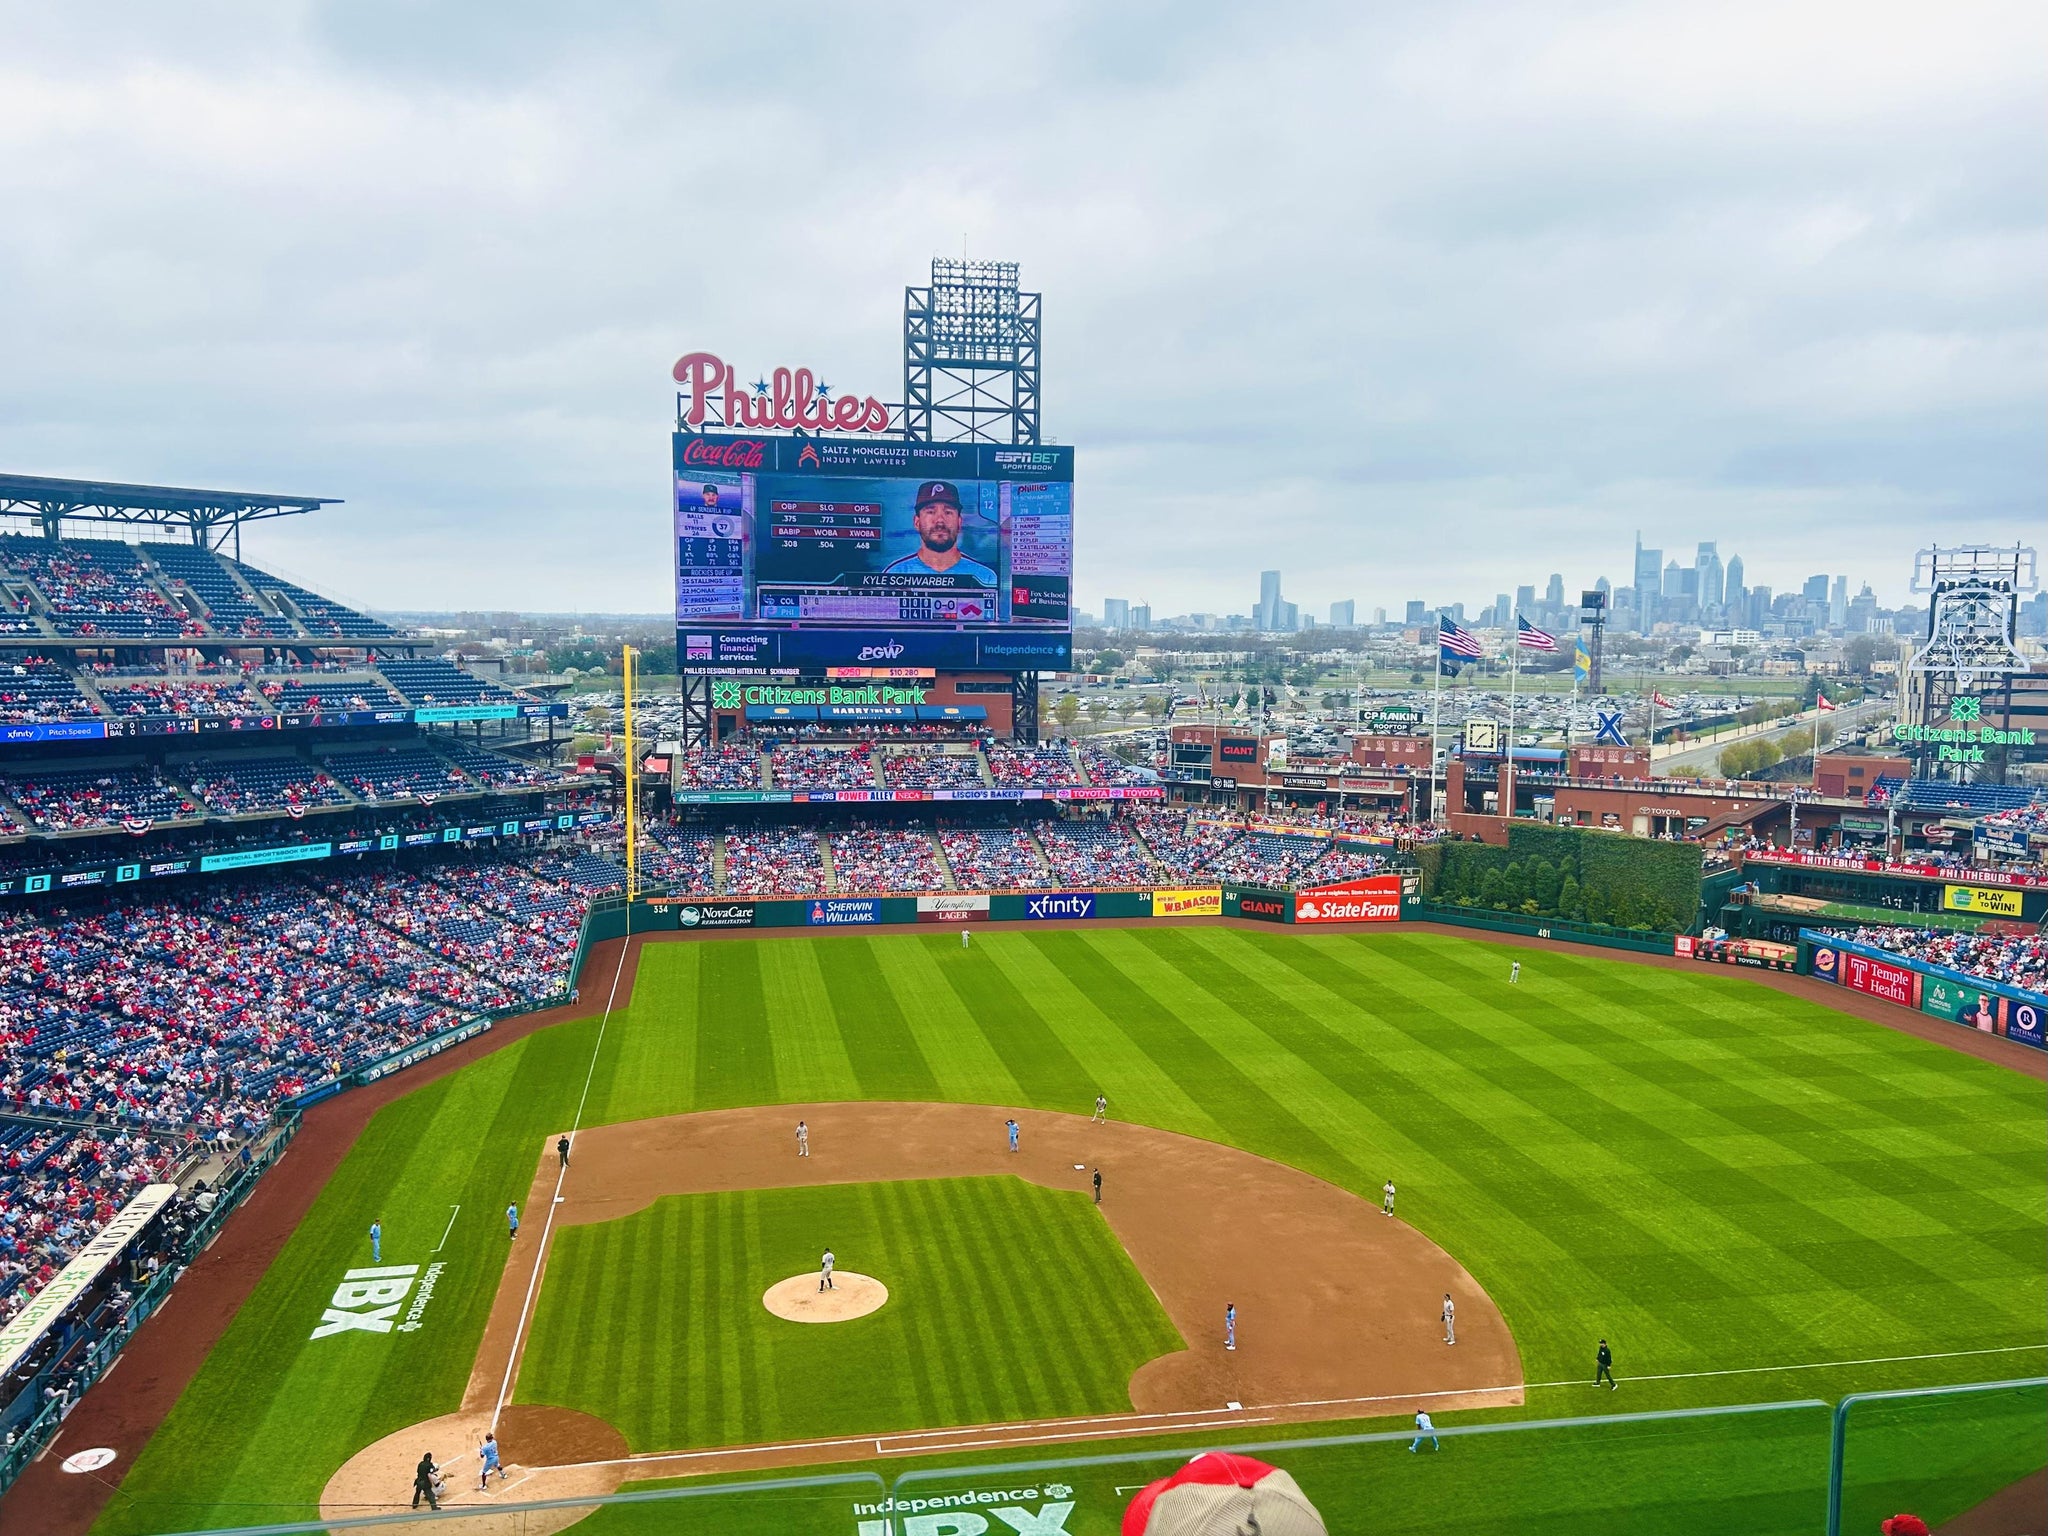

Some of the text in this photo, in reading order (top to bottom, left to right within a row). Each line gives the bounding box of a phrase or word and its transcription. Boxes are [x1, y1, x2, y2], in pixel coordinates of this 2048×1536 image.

[673, 352, 889, 432] Phillies
[822, 445, 958, 459] SALTZ MONGELUZZI BENDESKY
[822, 456, 906, 466] INJURY LAWYERS
[982, 488, 996, 498] DH
[984, 501, 993, 510] 12
[863, 576, 955, 586] KYLE SCHWARBER
[1043, 591, 1066, 599] School
[720, 635, 768, 645] Connecting
[720, 644, 757, 652] financial
[863, 646, 900, 659] PGW
[984, 645, 1053, 656] Independence
[720, 653, 757, 661] services.
[745, 685, 926, 705] Citizens Bank Park
[7, 730, 34, 739] xfinity
[68, 728, 91, 736] Speed
[1894, 724, 2035, 745] Citizens Bank
[1223, 747, 1254, 756] GIANT
[1939, 745, 1984, 763] Park
[838, 792, 894, 800] POWER ALLEY
[952, 789, 1024, 798] LISCIO'S BAKERY
[1072, 790, 1109, 798] TOYOTA
[1125, 789, 1161, 797] TOYOTA
[1651, 808, 1681, 816] TOYOTA
[1750, 851, 1793, 862] Budweiser
[1139, 893, 1151, 901] 374
[1226, 892, 1237, 900] 387
[1408, 897, 1420, 905] 409
[1978, 892, 2004, 902] PLAY
[827, 901, 872, 911] SHERWIN
[931, 896, 976, 910] Yuengling
[1029, 895, 1091, 918] xfinity
[1240, 900, 1283, 914] GIANT
[1990, 902, 2015, 912] WIN!
[654, 905, 668, 913] 334
[701, 906, 753, 918] NovaCare
[939, 911, 968, 920] LAGER
[1537, 928, 1550, 938] 401
[1738, 957, 1761, 965] TOYOTA
[1871, 963, 1909, 986] Temple
[1870, 979, 1905, 1001] Health
[82, 1200, 158, 1258] WELCOME
[406, 1261, 448, 1321] Independence
[309, 1264, 420, 1340] IBX
[8, 1282, 77, 1334] Citizens
[853, 1486, 1038, 1515] Independence
